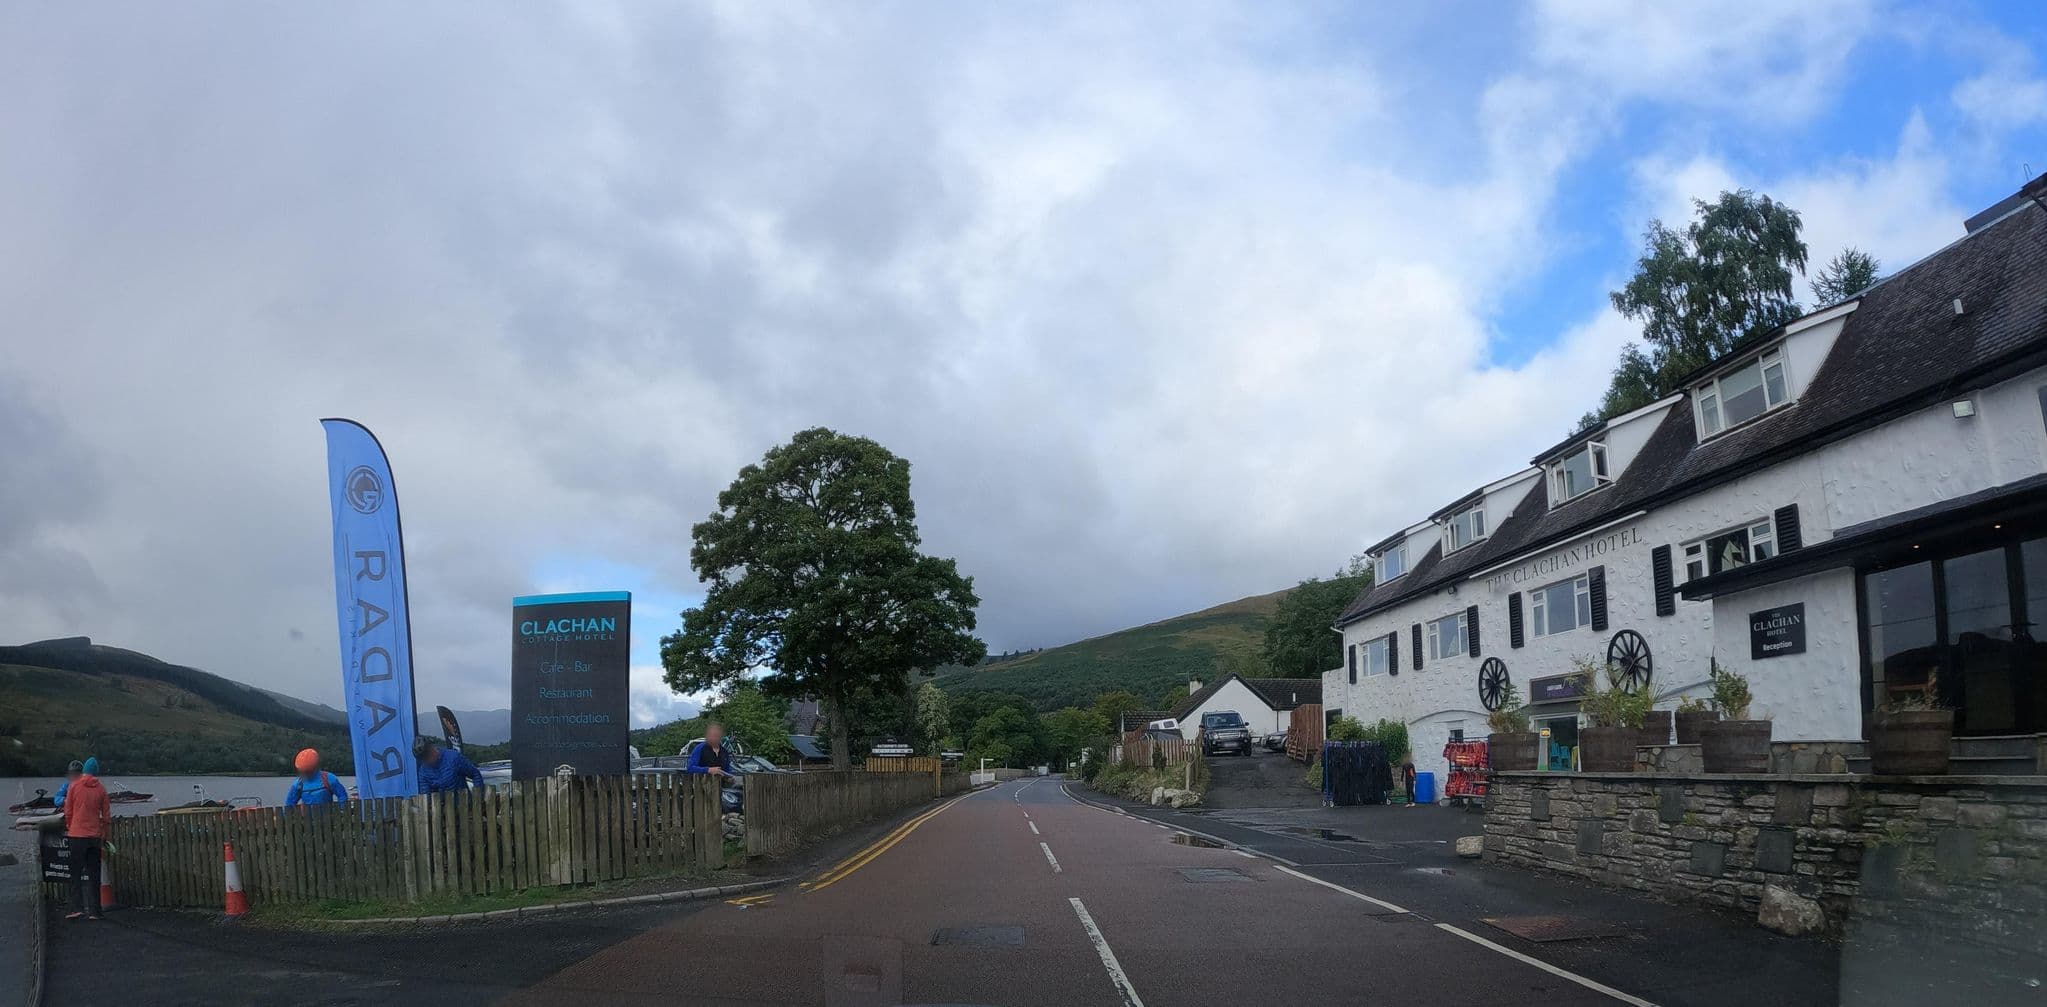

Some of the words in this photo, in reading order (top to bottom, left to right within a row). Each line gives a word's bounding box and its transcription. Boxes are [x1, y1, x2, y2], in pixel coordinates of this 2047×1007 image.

[1513, 549, 1580, 584] CLACHAN
[1584, 527, 1643, 560] HOTEL
[520, 617, 616, 636] CLACHAN
[1753, 614, 1801, 632] CLACHAN
[1766, 627, 1788, 637] HOTEL
[521, 634, 570, 645] COTTAGE
[575, 633, 615, 641] HOTEL
[1762, 640, 1793, 651] Reception
[574, 660, 593, 673] Bar
[539, 686, 593, 699] Restaurant
[525, 712, 610, 726] Accommodation
